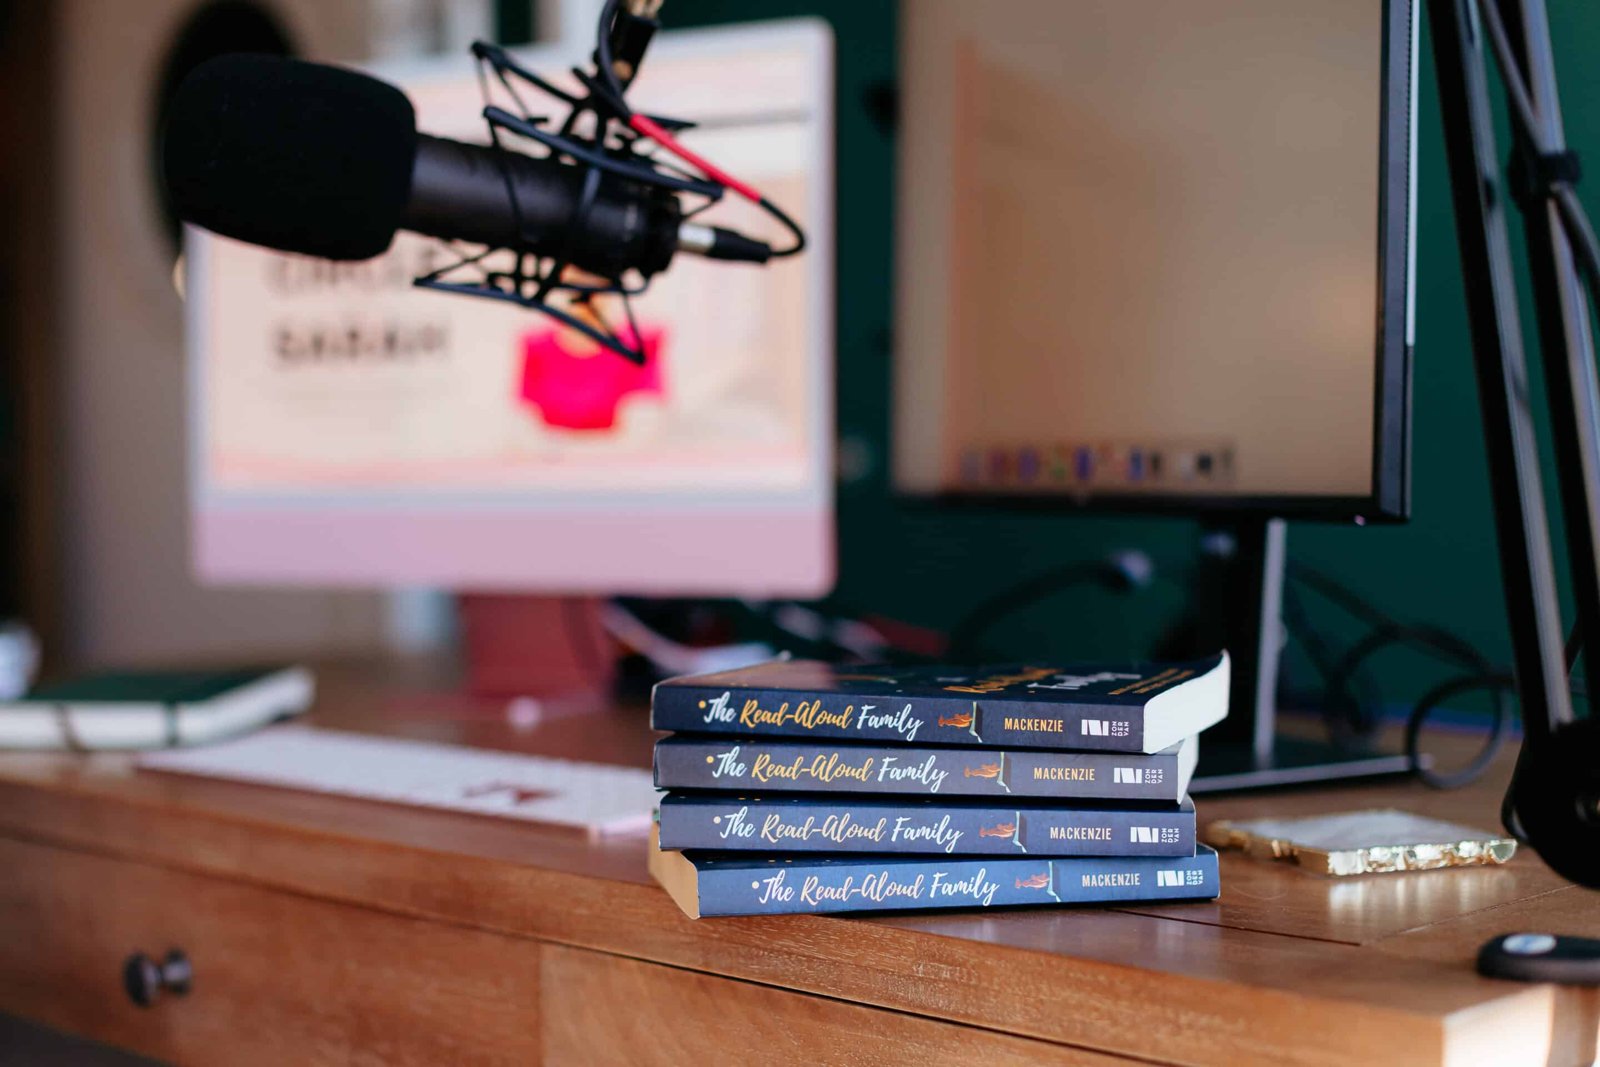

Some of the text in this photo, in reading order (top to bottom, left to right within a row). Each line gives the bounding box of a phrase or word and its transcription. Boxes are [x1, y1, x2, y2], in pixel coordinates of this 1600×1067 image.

[704, 691, 925, 741] The Read-Aloud Family
[1004, 718, 1064, 733] MACKENZIE
[712, 746, 949, 793] The Read-Aloud Family
[1033, 767, 1095, 781] MACKENZIE
[720, 806, 964, 853] The Read-Aloud Family
[1050, 826, 1112, 841] MACKENZIE
[758, 868, 1000, 906] The Read-Aloud Family
[1082, 873, 1140, 888] MACKENZIE
